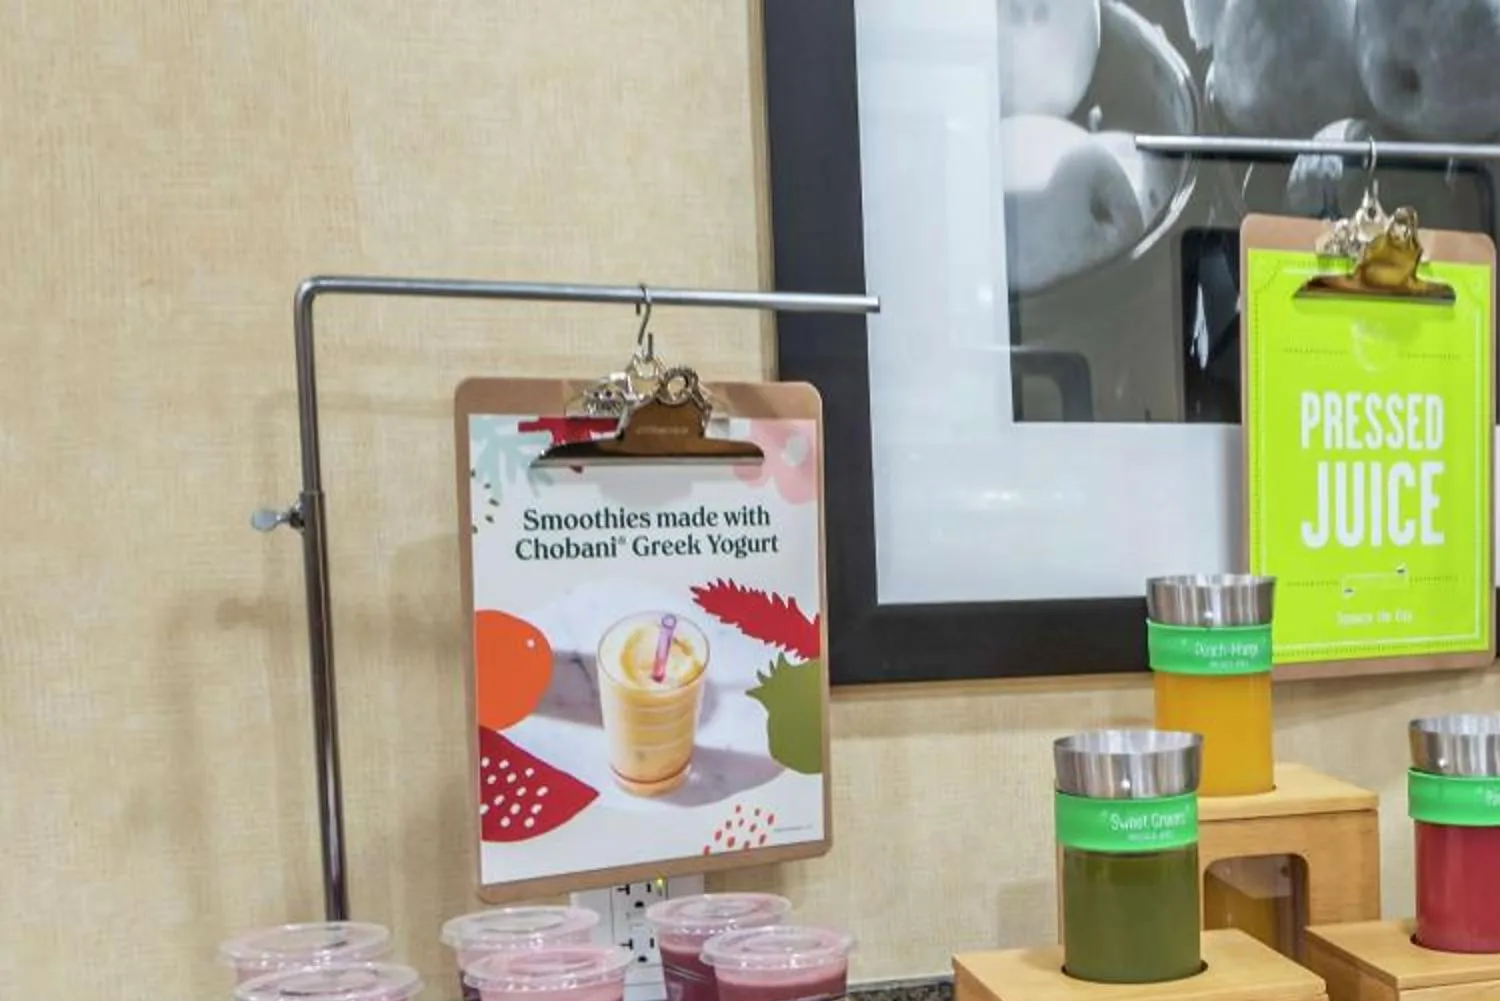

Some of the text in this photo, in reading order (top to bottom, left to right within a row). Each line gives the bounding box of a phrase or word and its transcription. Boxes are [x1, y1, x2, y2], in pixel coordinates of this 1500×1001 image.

[1300, 390, 1445, 450] PRESSED
[523, 505, 771, 531] Smoothies made with
[1301, 461, 1445, 548] JUICE
[632, 535, 701, 557] Greek
[708, 534, 779, 559] Yogurt
